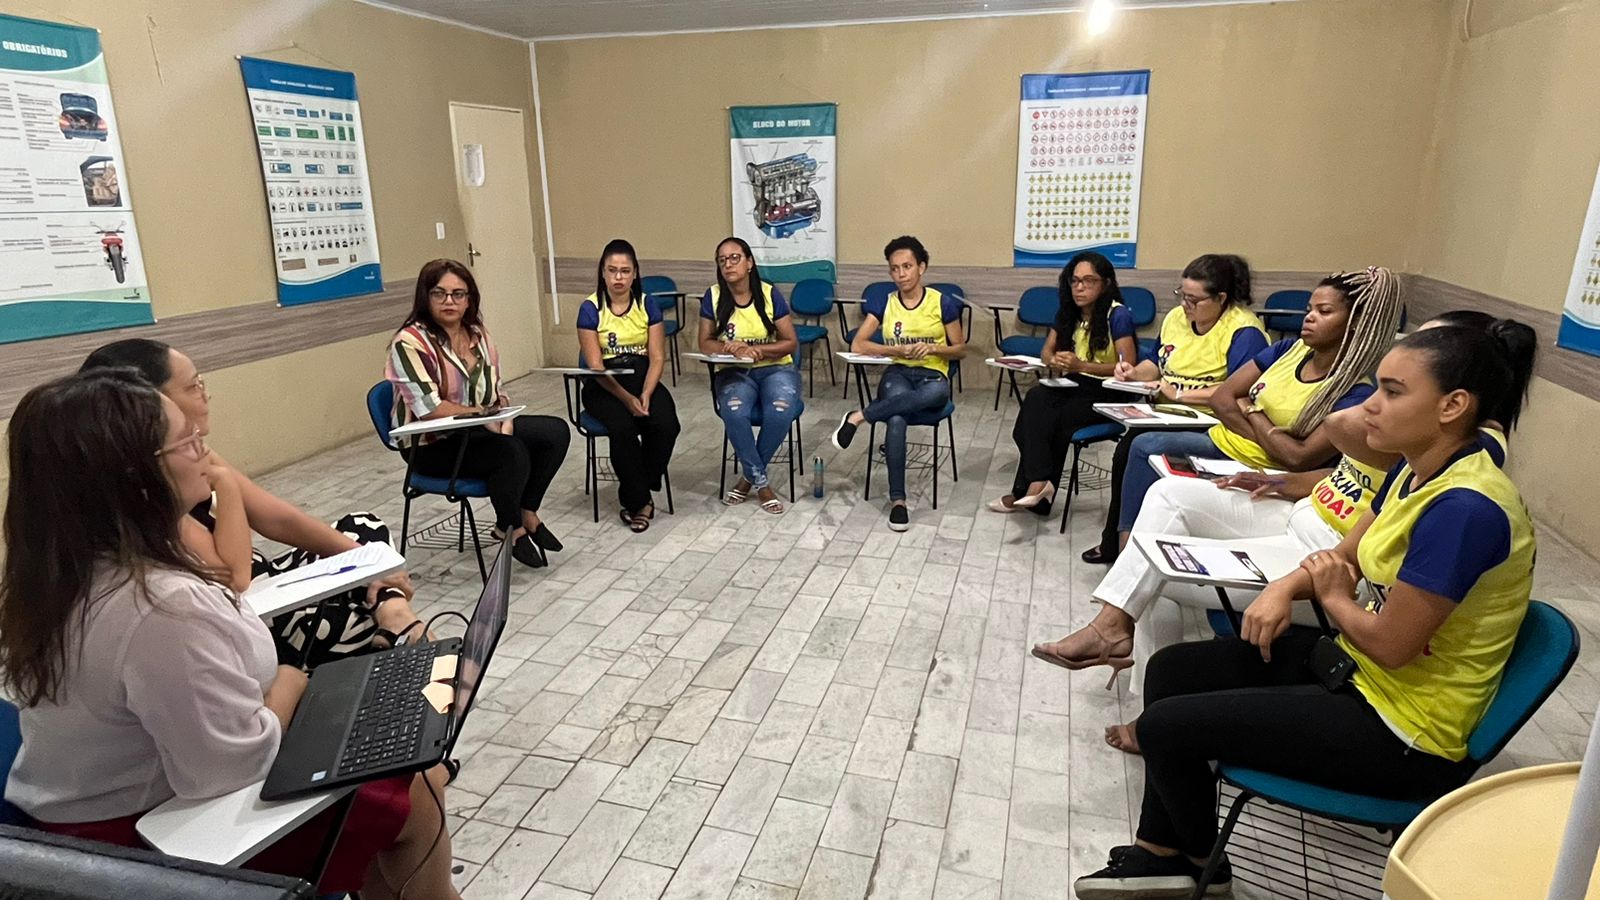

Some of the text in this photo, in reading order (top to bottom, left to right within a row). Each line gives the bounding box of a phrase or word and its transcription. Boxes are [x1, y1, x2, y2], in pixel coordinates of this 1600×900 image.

[2, 40, 68, 59] OBRIGATÓRIOS
[752, 118, 811, 129] BLOCO DO MOTOR
[1315, 481, 1356, 520] VIDA!
